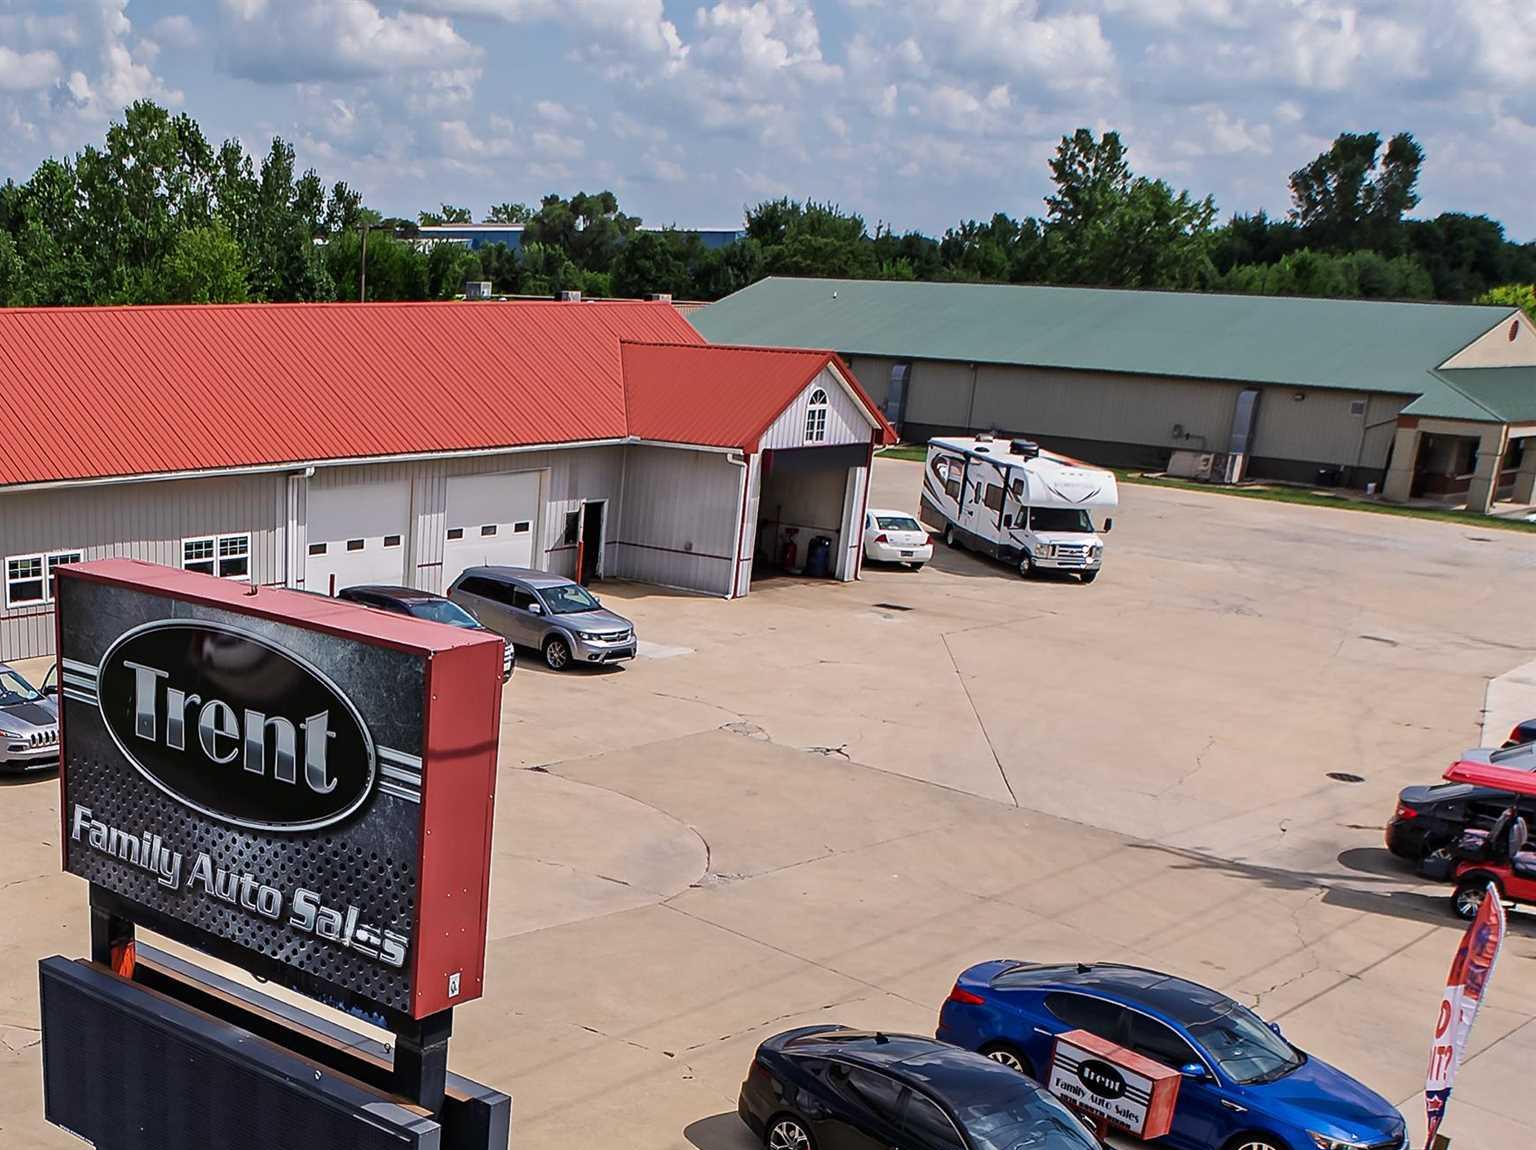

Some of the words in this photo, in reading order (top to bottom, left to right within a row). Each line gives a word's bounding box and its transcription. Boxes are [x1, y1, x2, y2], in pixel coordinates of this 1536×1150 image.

[123, 660, 337, 794] Trent
[71, 804, 182, 890] Family
[185, 852, 283, 921] Auto
[289, 887, 409, 968] Sales
[1055, 1077, 1086, 1098] Family
[1090, 1094, 1112, 1111] Auto
[1115, 1104, 1140, 1124] Sales
[1084, 1066, 1121, 1093] Trent
